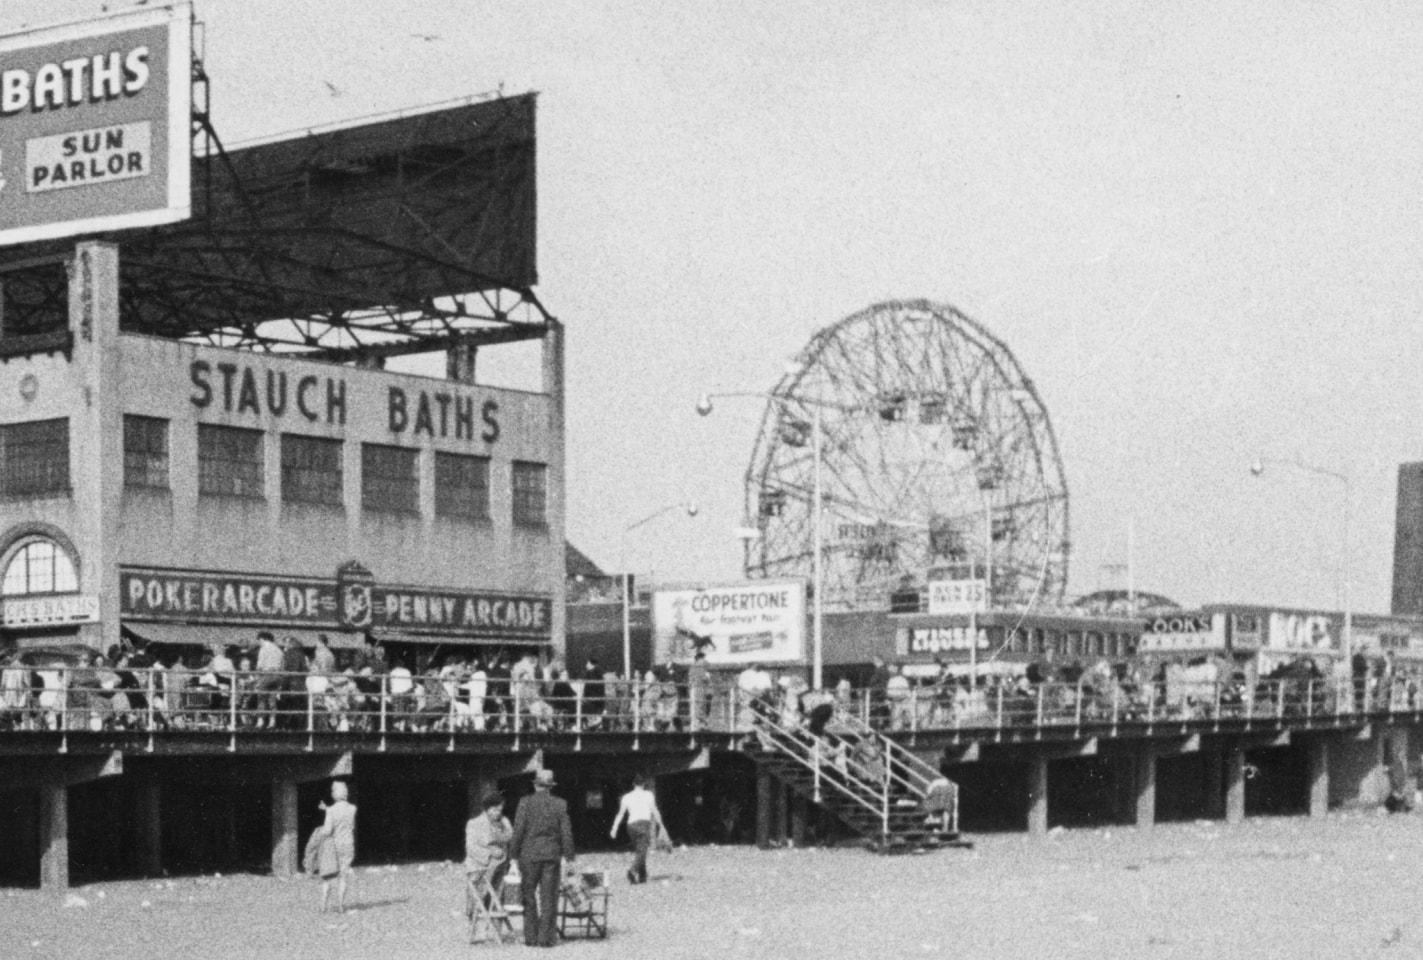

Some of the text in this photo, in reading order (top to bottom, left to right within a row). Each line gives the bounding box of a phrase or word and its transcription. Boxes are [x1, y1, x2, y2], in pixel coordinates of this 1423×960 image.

[0, 46, 151, 117] BATHS
[62, 129, 125, 156] SUN
[33, 152, 144, 186] PARLOR
[190, 359, 501, 445] STAUCH BATHS
[385, 593, 457, 624] PENNY
[463, 598, 546, 629] ARCADE
[692, 590, 789, 612] COPPERTONE
